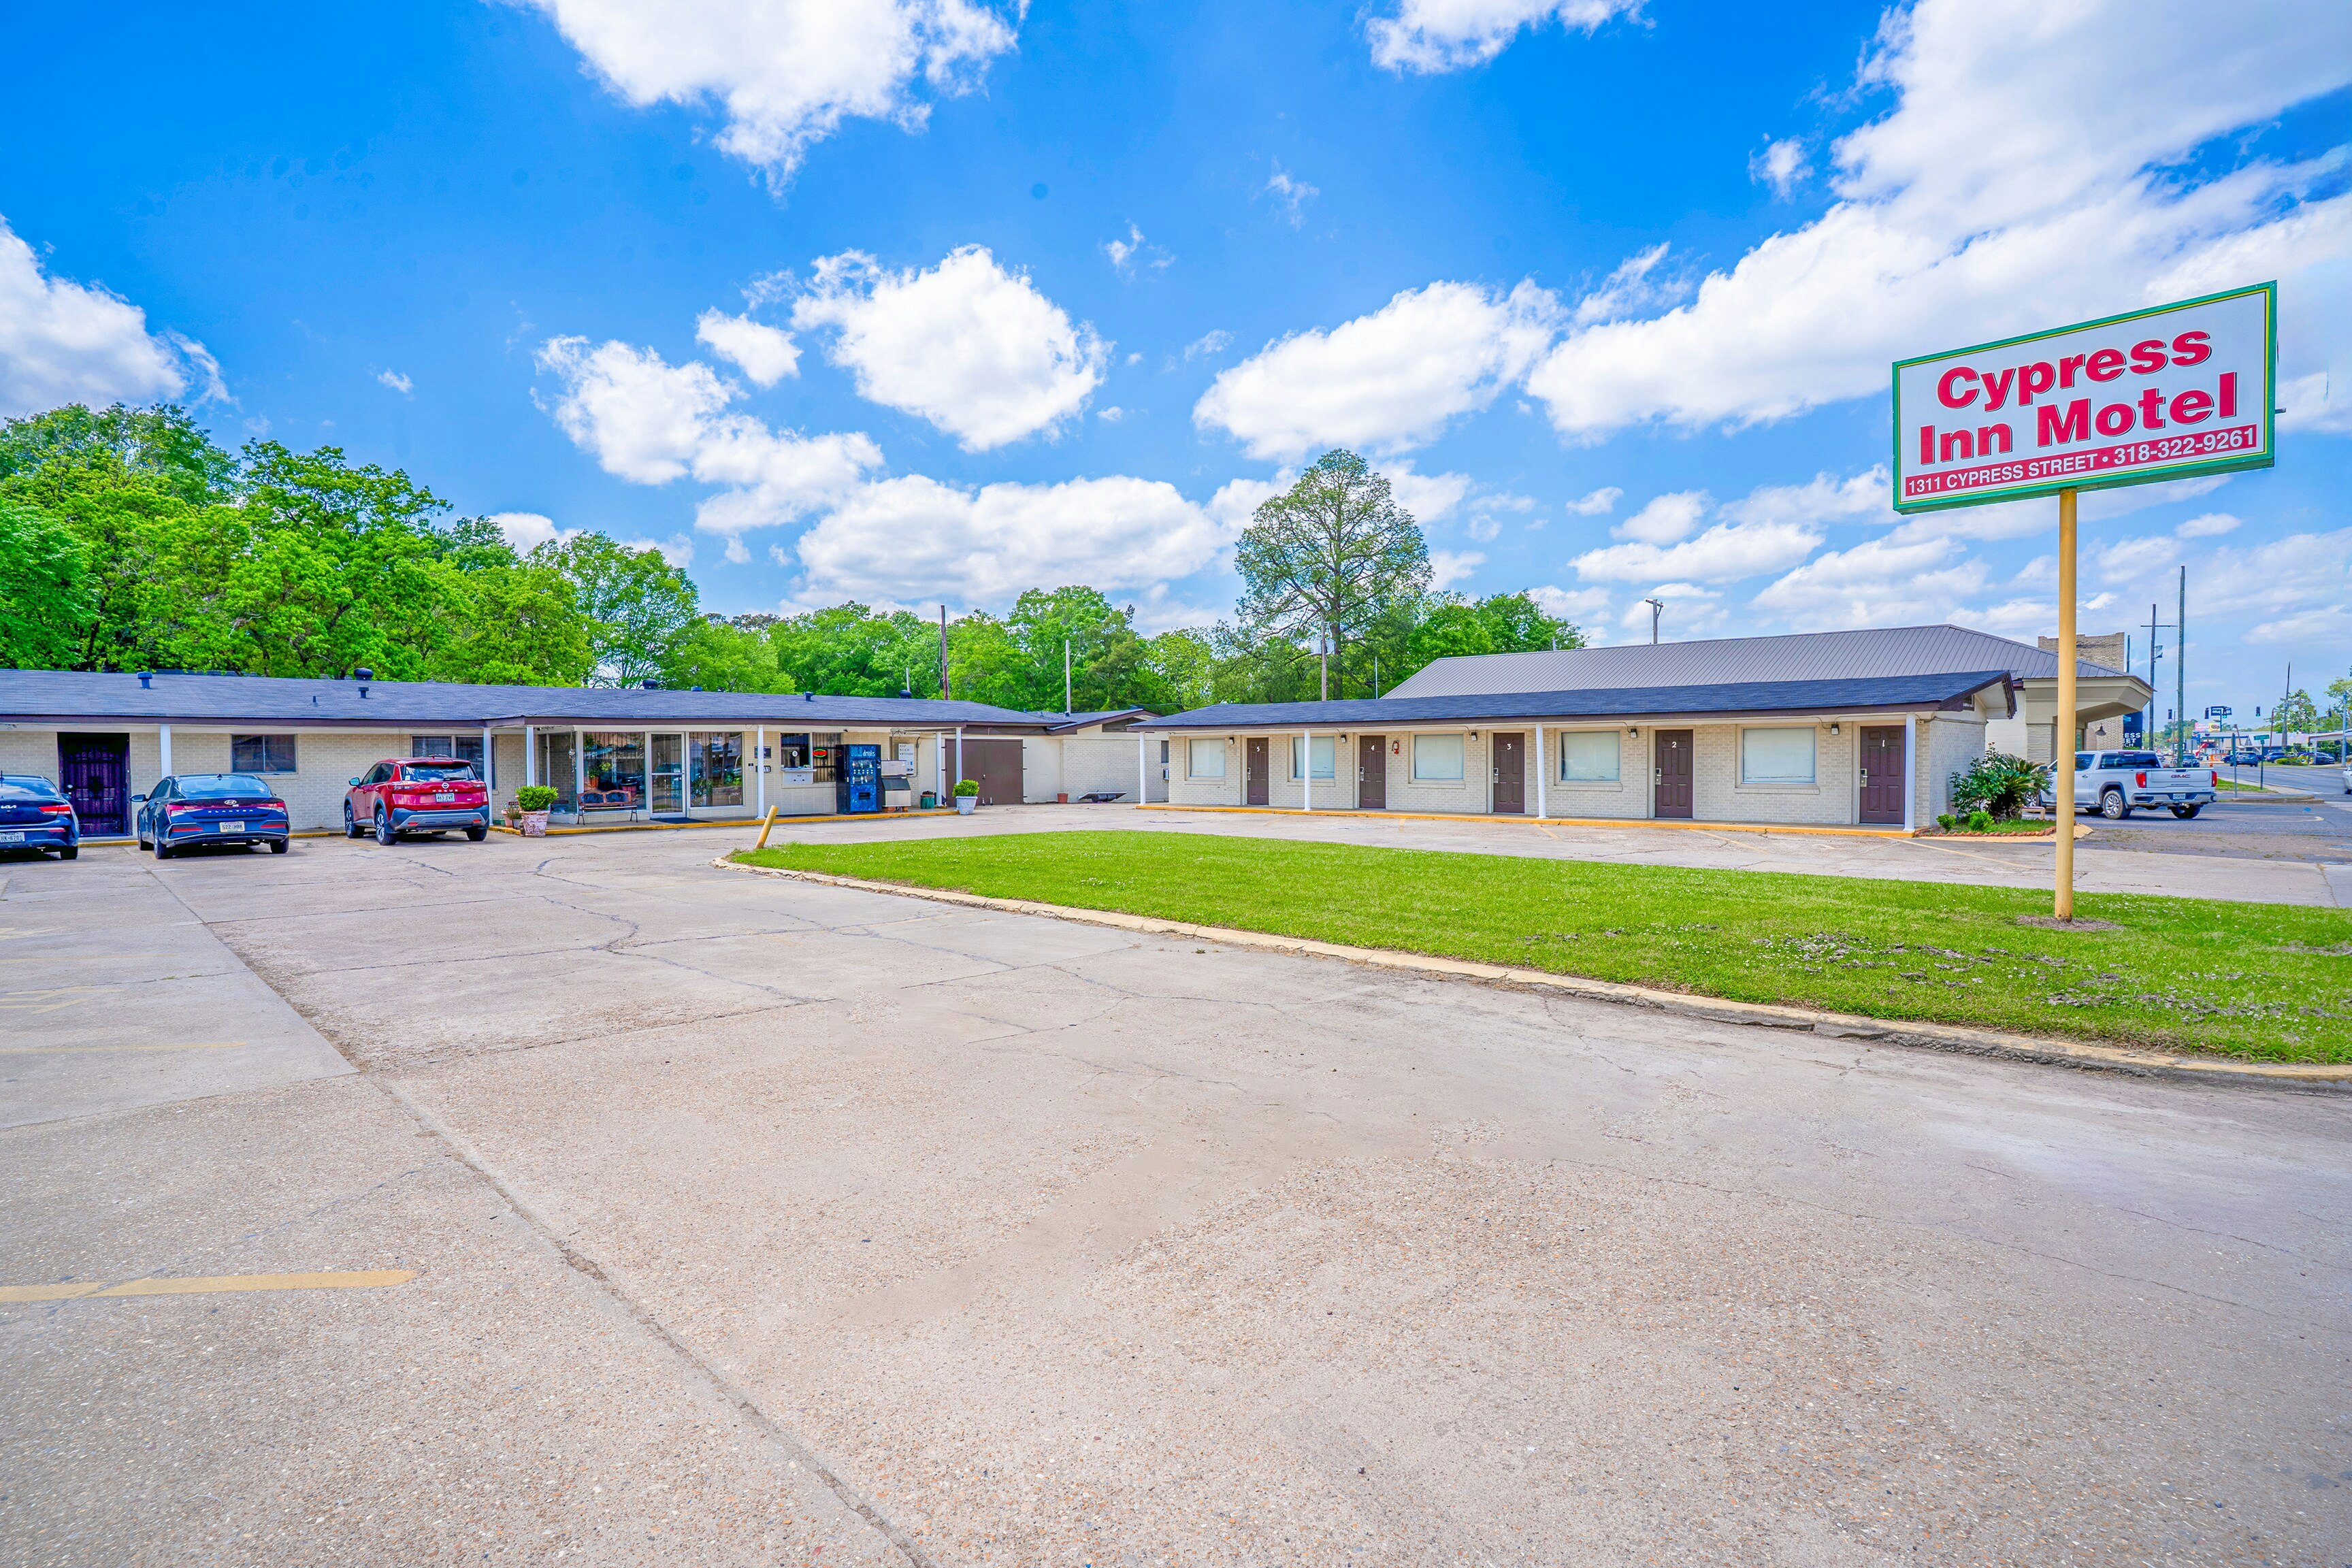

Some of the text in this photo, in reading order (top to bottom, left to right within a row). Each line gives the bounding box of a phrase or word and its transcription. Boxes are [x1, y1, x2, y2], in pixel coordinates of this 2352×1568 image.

[1936, 330, 2212, 412] Cypress
[1920, 372, 2237, 466] Inn Motel
[1908, 427, 2254, 494] 1311 CYPRESS STREET 318-322-9261
